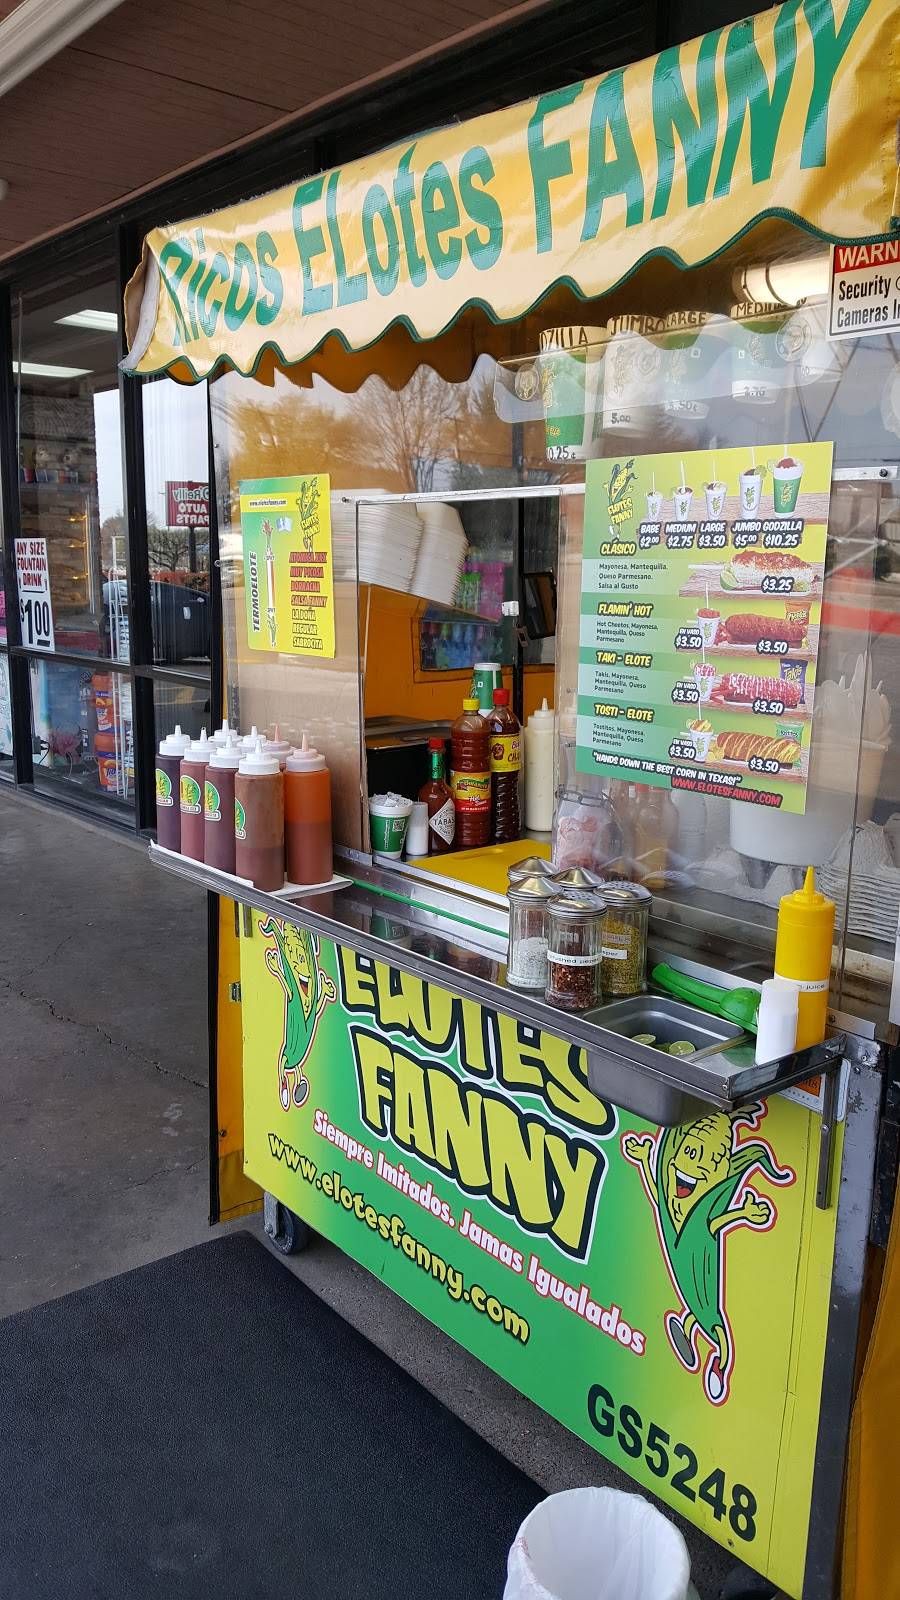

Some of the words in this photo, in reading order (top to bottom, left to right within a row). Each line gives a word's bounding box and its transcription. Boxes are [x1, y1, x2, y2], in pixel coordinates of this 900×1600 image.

[528, 0, 873, 254] FANNY
[839, 240, 900, 269] WARN
[839, 274, 891, 301] Security
[666, 311, 706, 328] LARGE
[837, 305, 888, 328] Cameras
[611, 412, 631, 424] 5.00
[640, 524, 660, 534] BABE
[666, 523, 697, 533] MEDIUM
[700, 522, 726, 532] LARGE
[732, 521, 761, 531] JUMBO
[763, 521, 802, 531] GODZILLA
[601, 540, 635, 554] CLÁSICO
[640, 536, 659, 547] $2.00
[667, 535, 693, 547] $2.75
[698, 535, 726, 547] $3.50
[734, 535, 757, 547] $5.00
[765, 534, 799, 547] $10.25
[17, 542, 27, 555] ANY
[30, 542, 44, 555] SIZE
[17, 558, 46, 571] FOUNTAIN
[23, 573, 42, 586] DRINK
[763, 579, 793, 591] $3.25
[249, 552, 261, 632] TERMOELOTE
[292, 609, 300, 620] LA
[598, 603, 632, 615] FLAMIN'
[634, 605, 652, 616] HOT
[292, 623, 317, 635] REGULAR
[596, 629, 627, 637] Mantequilla,
[631, 623, 658, 631] Mayonesa,
[293, 637, 323, 650] SABROCITA
[676, 636, 702, 648] $3.50
[758, 640, 788, 653] $3.50
[597, 652, 616, 663] TAKI
[625, 655, 651, 666] ELOTE
[595, 686, 624, 694] Parmesano
[672, 690, 699, 702] $3.50
[595, 704, 618, 716] TOSTI
[627, 708, 653, 721] ELOTE
[754, 699, 784, 713] $3.50
[592, 738, 621, 746] Parmesano
[669, 746, 695, 759] $3.50
[620, 757, 640, 769] DOWN
[642, 761, 655, 771] THE
[657, 765, 674, 775] BEST
[676, 768, 696, 778] CORN
[698, 772, 706, 780] IN
[750, 758, 779, 772] $3.50
[671, 777, 781, 806] WWW.ELOTESFANNY.COM
[806, 982, 825, 990] juice
[352, 1028, 602, 1256] FANNY
[314, 1108, 374, 1169] Siempre
[376, 1151, 455, 1228] Imitados.
[459, 1208, 524, 1274] Jamas
[527, 1252, 646, 1356] Igualados
[268, 1133, 530, 1345] www.elotesfanny.com
[587, 1384, 757, 1542] GS5248
